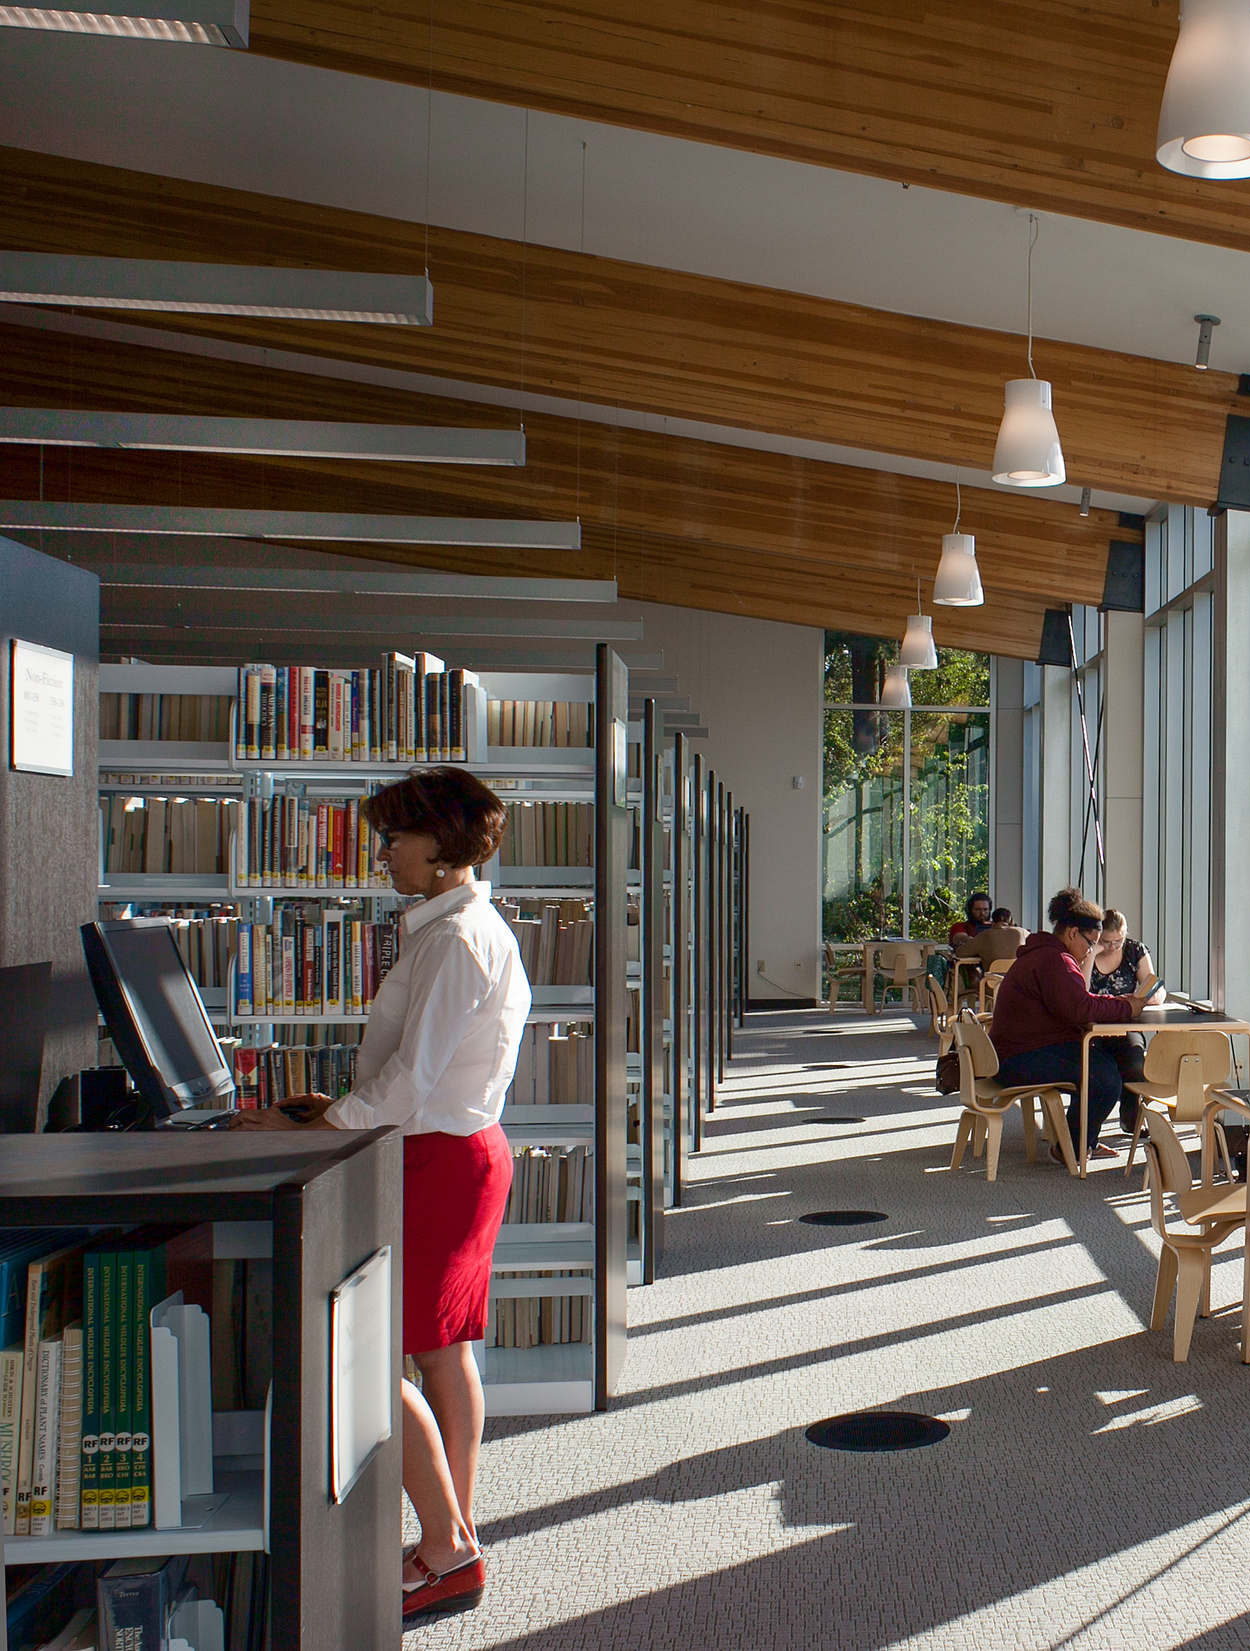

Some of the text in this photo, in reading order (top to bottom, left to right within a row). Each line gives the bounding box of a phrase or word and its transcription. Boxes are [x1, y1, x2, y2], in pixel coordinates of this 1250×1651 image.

[25, 667, 64, 689] Non-Fiction
[381, 934, 393, 966] TRIPLE
[28, 1302, 37, 1331] Endangered
[120, 1265, 128, 1412] INTERNATIONAL WILDLIFE ENCYCLOPEDIA
[136, 1264, 144, 1412] INTERNATIONAL WILDLIFE ENCYCLOPEDIA
[26, 1353, 34, 1371] Oregon
[2, 1394, 8, 1402] TO
[38, 1350, 50, 1461] DICTIONARY of PLANT NAMES
[84, 1440, 98, 1448] RF
[100, 1437, 114, 1446] RF
[116, 1436, 131, 1446] RF
[133, 1437, 148, 1446] RF
[1, 1422, 14, 1485] MUSHRO
[120, 1454, 126, 1462] 3
[136, 1453, 143, 1461] 4
[3, 1488, 10, 1496] F
[18, 1492, 32, 1502] RF
[34, 1486, 48, 1496] RF
[119, 1590, 140, 1598] Terres
[124, 1626, 134, 1651] ENCYC
[134, 1625, 143, 1640] The
[115, 1628, 124, 1651] NORT
